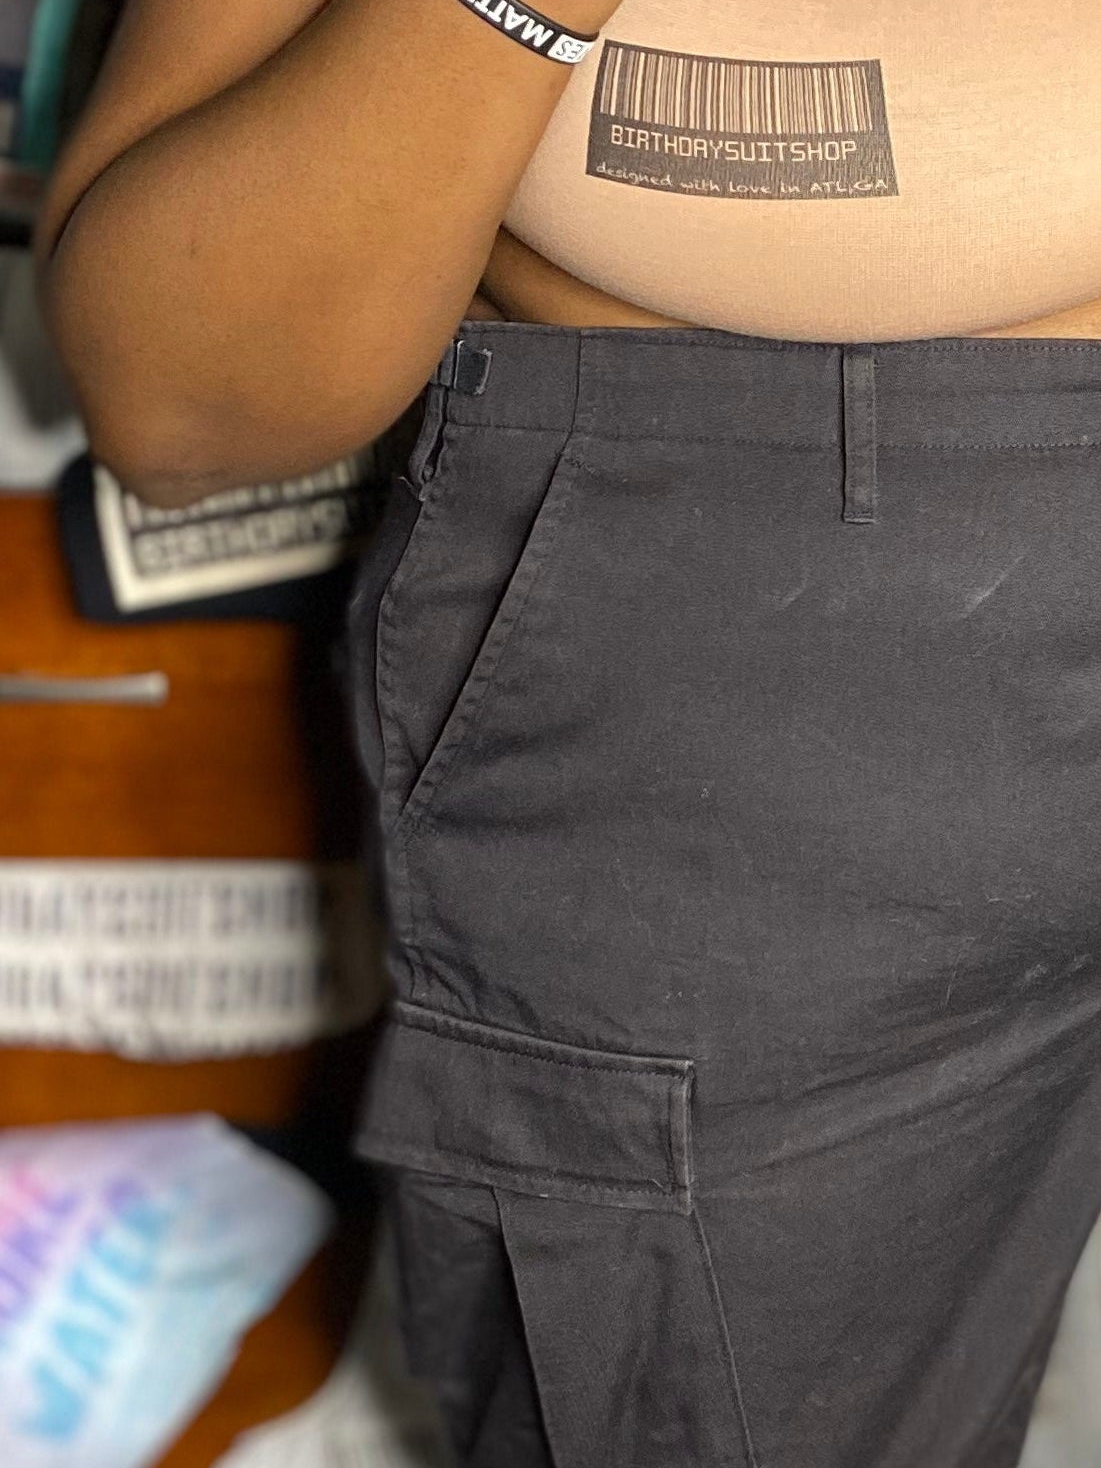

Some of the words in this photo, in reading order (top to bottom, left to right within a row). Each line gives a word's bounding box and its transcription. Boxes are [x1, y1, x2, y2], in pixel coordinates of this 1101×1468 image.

[610, 124, 857, 162] BIRTHDAYSUITSHOP
[596, 161, 673, 187] designed
[681, 179, 720, 192] with
